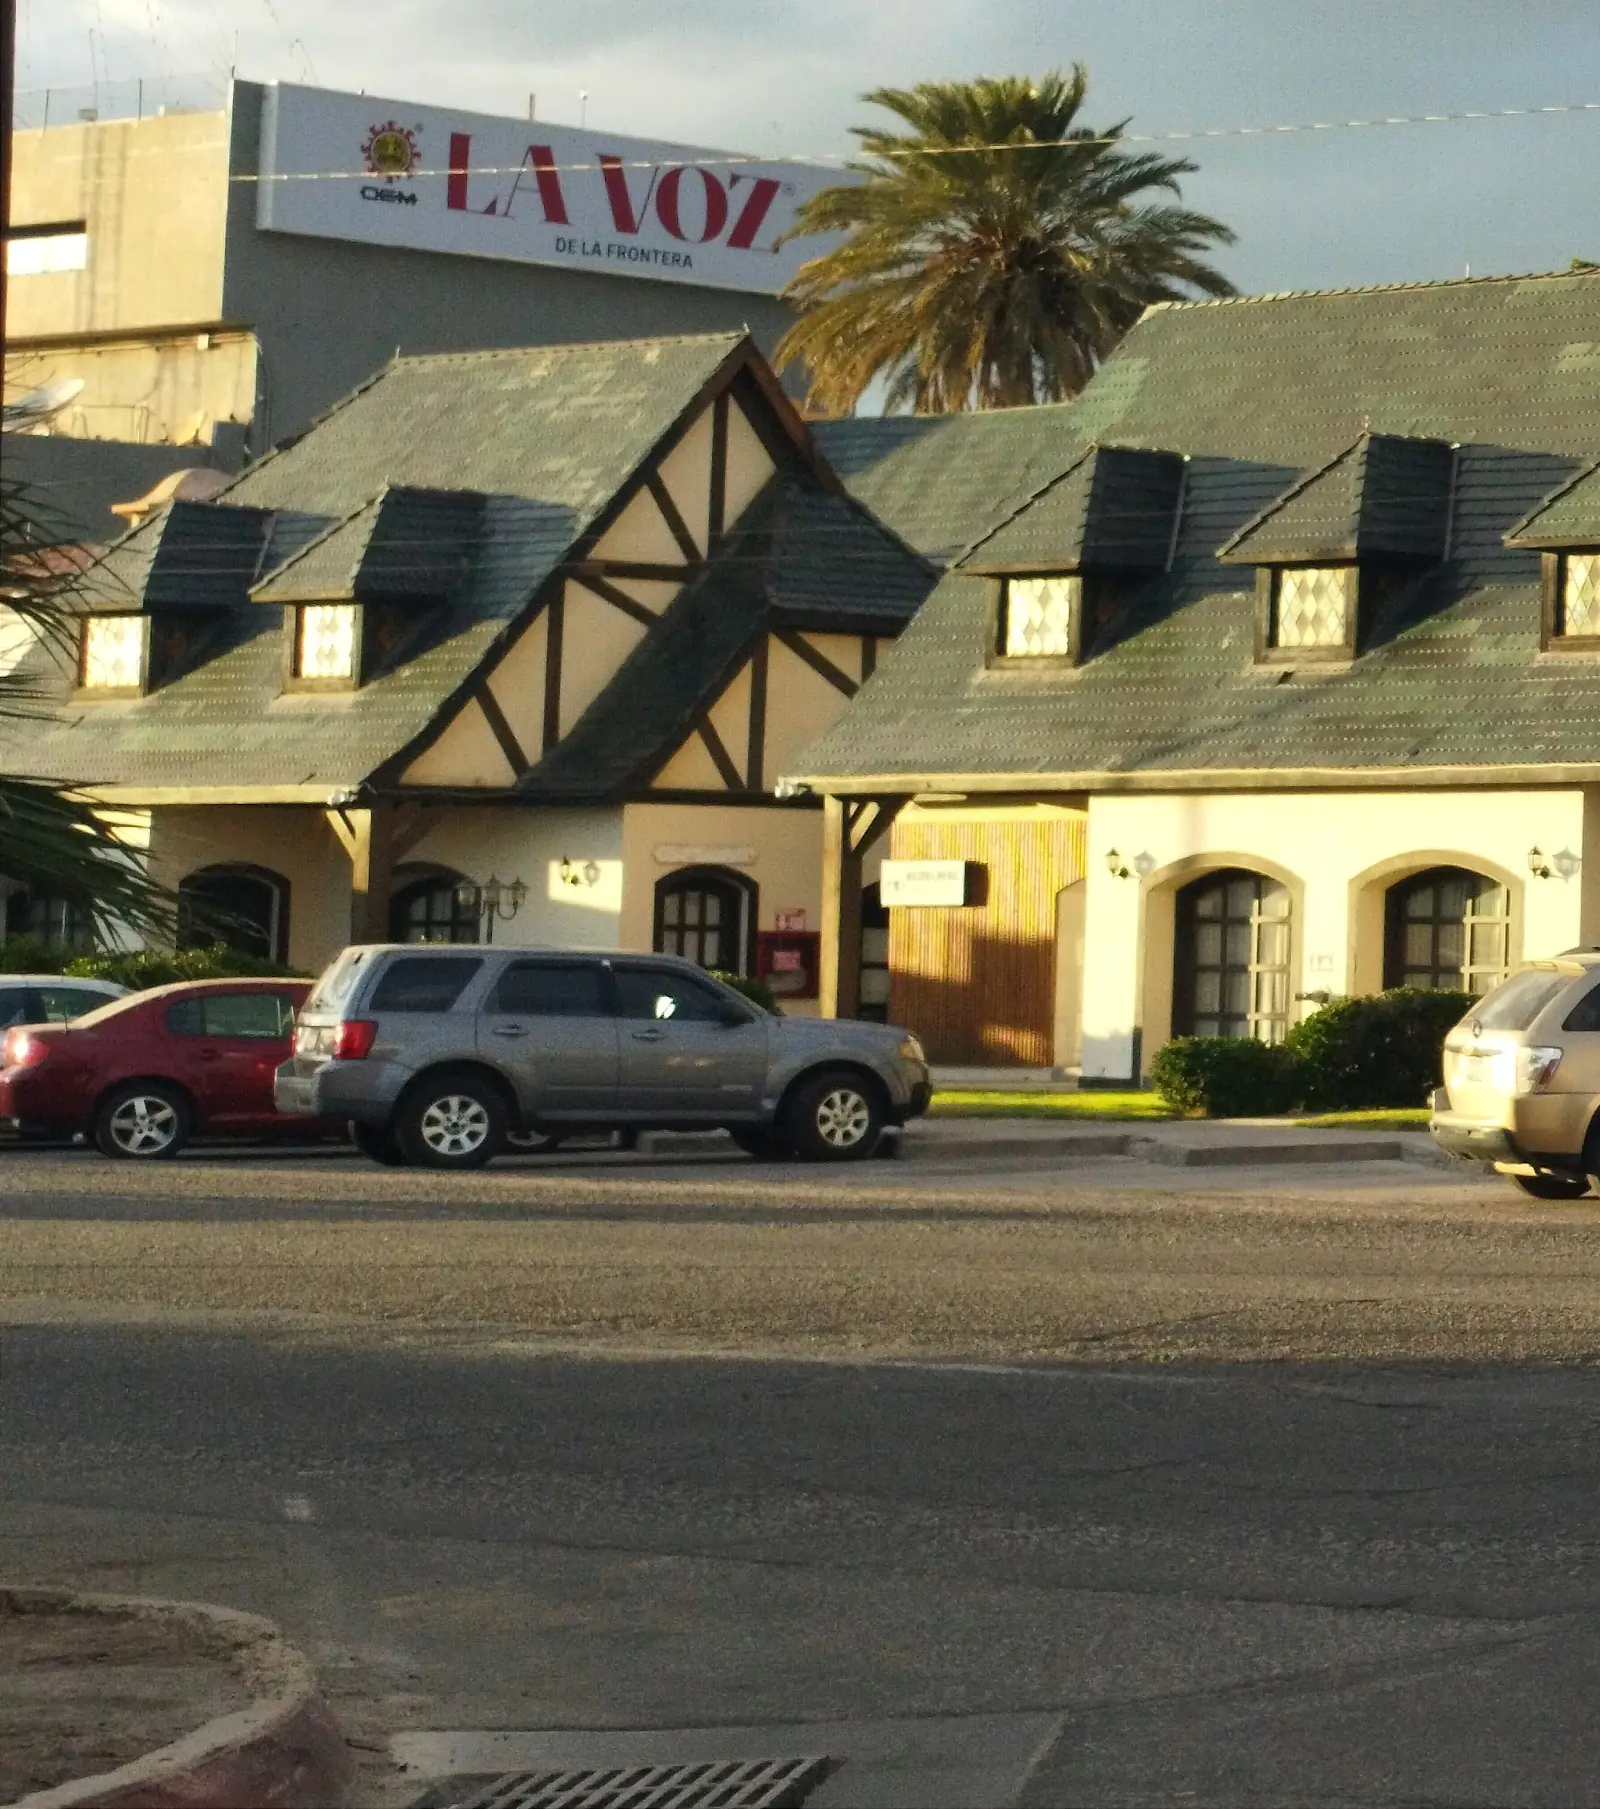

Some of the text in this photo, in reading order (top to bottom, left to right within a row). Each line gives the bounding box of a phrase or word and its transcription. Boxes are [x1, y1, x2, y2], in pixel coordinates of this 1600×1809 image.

[360, 185, 417, 206] OEM
[447, 132, 783, 254] LA VOZ
[555, 236, 693, 269] DE LA FRONTERA
